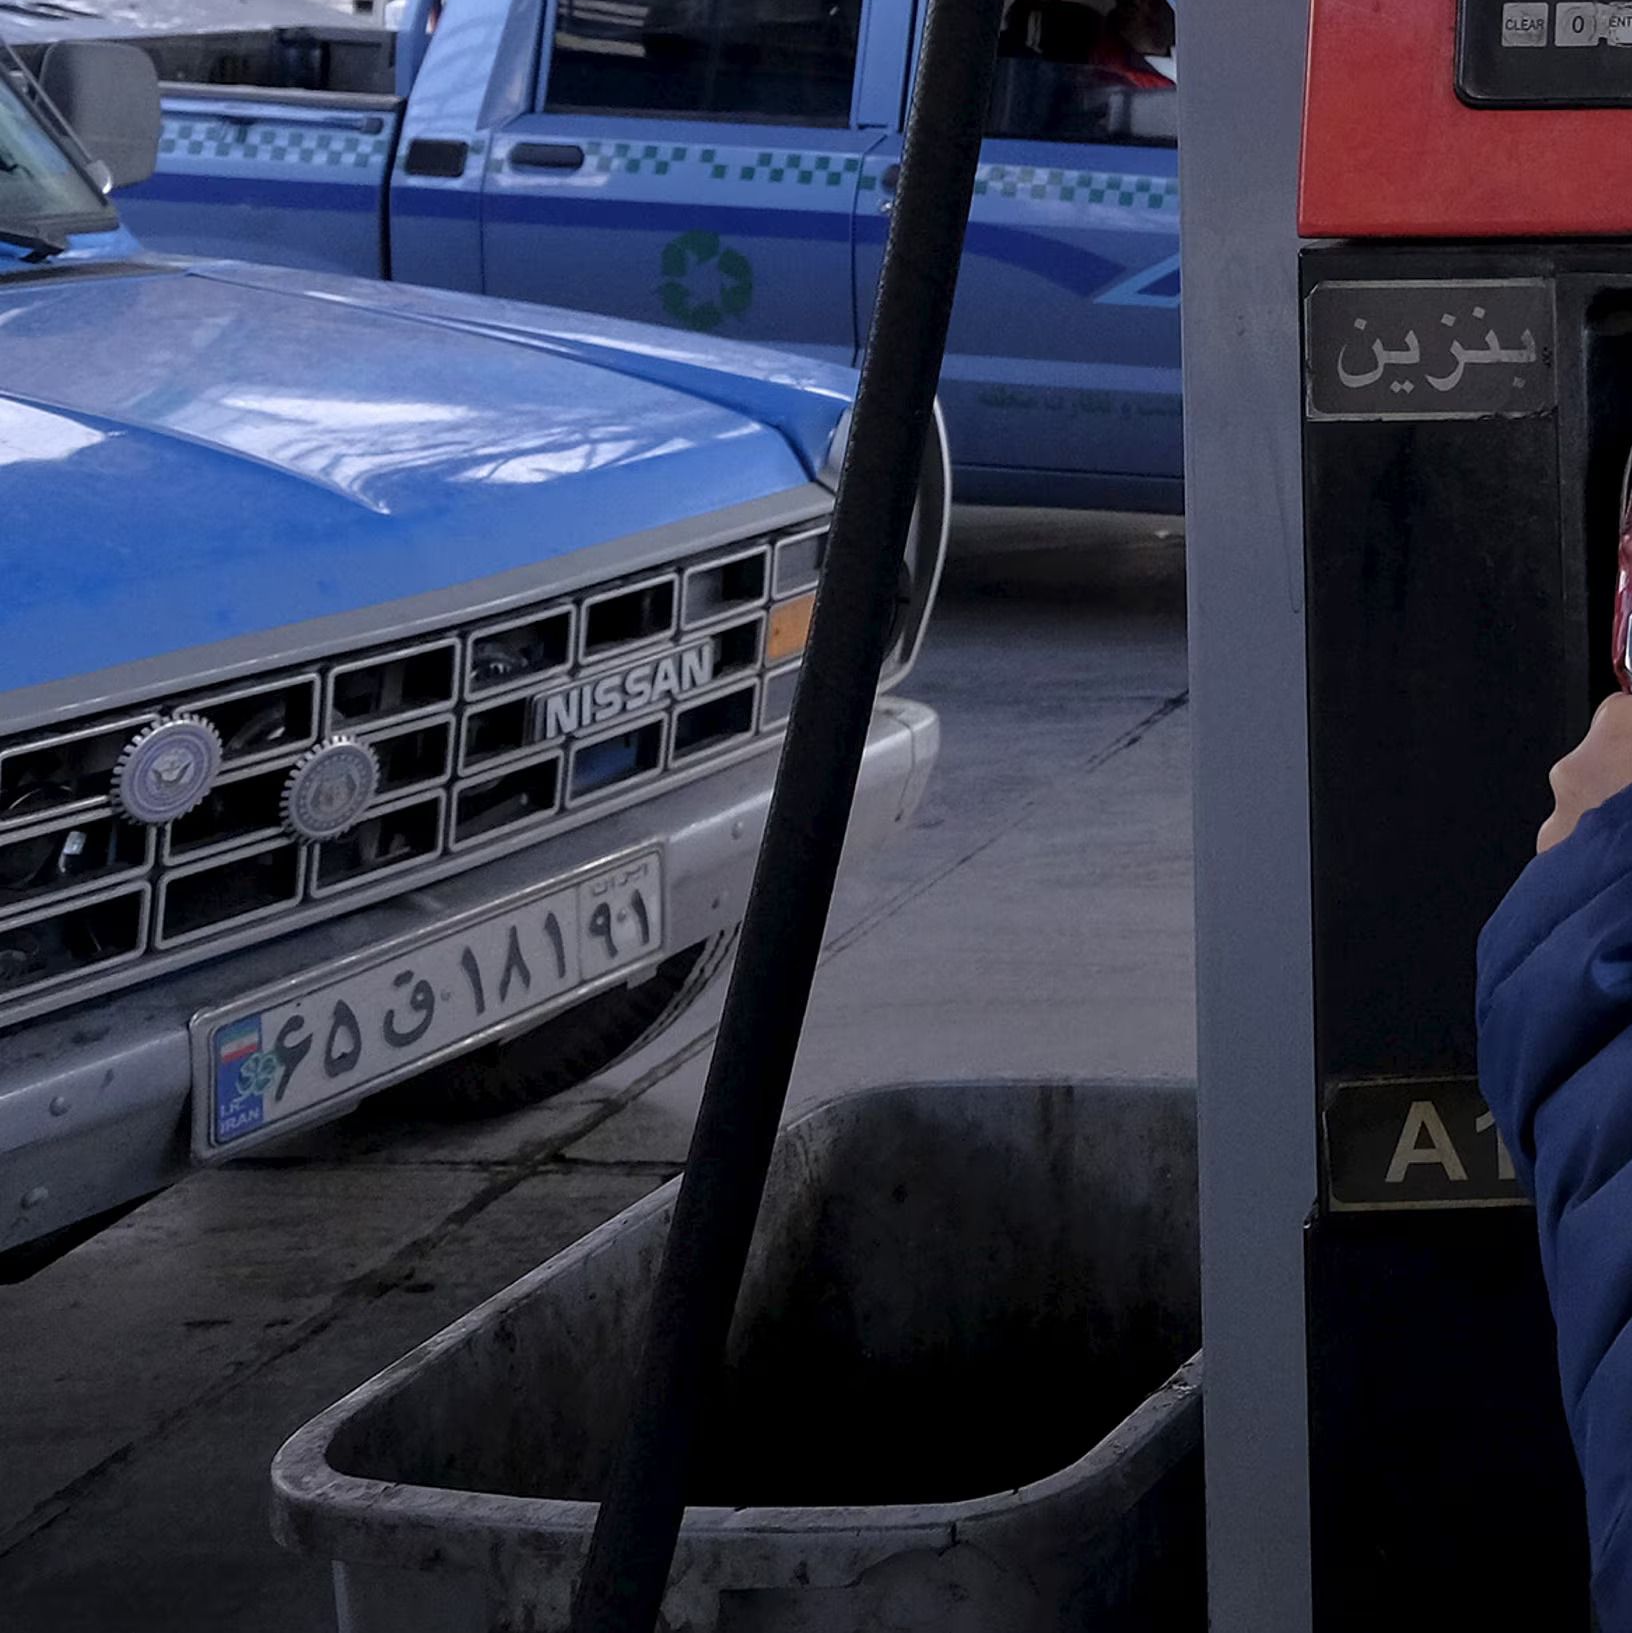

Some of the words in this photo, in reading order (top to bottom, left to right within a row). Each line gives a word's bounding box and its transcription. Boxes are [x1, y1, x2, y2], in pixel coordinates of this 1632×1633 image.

[1505, 19, 1545, 31] CLEAR
[1572, 16, 1584, 33] 0
[1336, 306, 1538, 394] بنزین
[544, 646, 713, 739] NISSAN
[219, 1106, 260, 1135] IRAN
